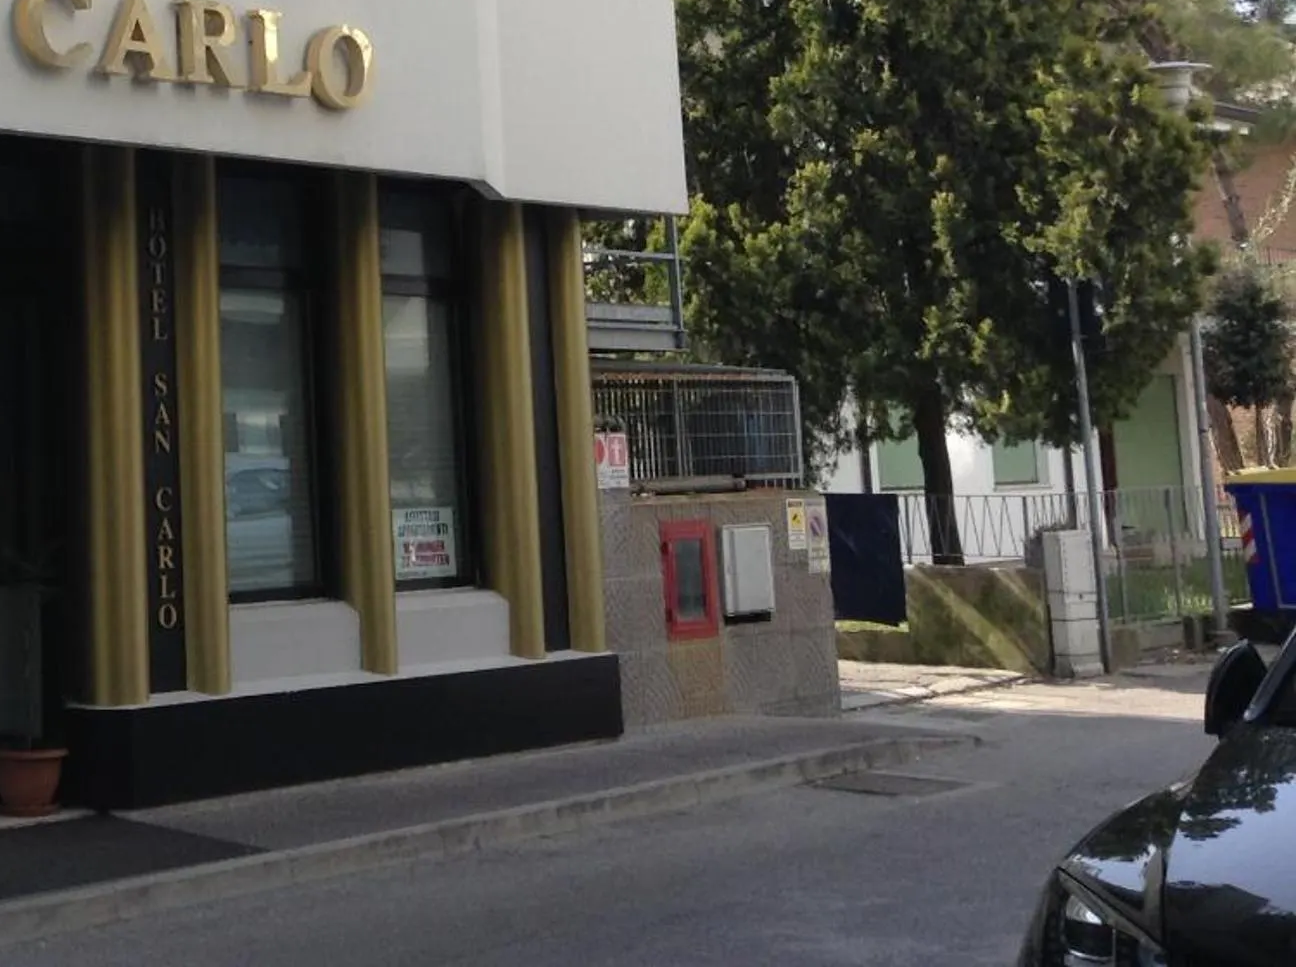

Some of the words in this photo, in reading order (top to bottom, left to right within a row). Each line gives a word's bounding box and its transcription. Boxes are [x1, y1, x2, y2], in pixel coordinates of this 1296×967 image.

[149, 206, 169, 341] HOTEL
[154, 373, 170, 453] SAN
[156, 487, 177, 629] CARLO
